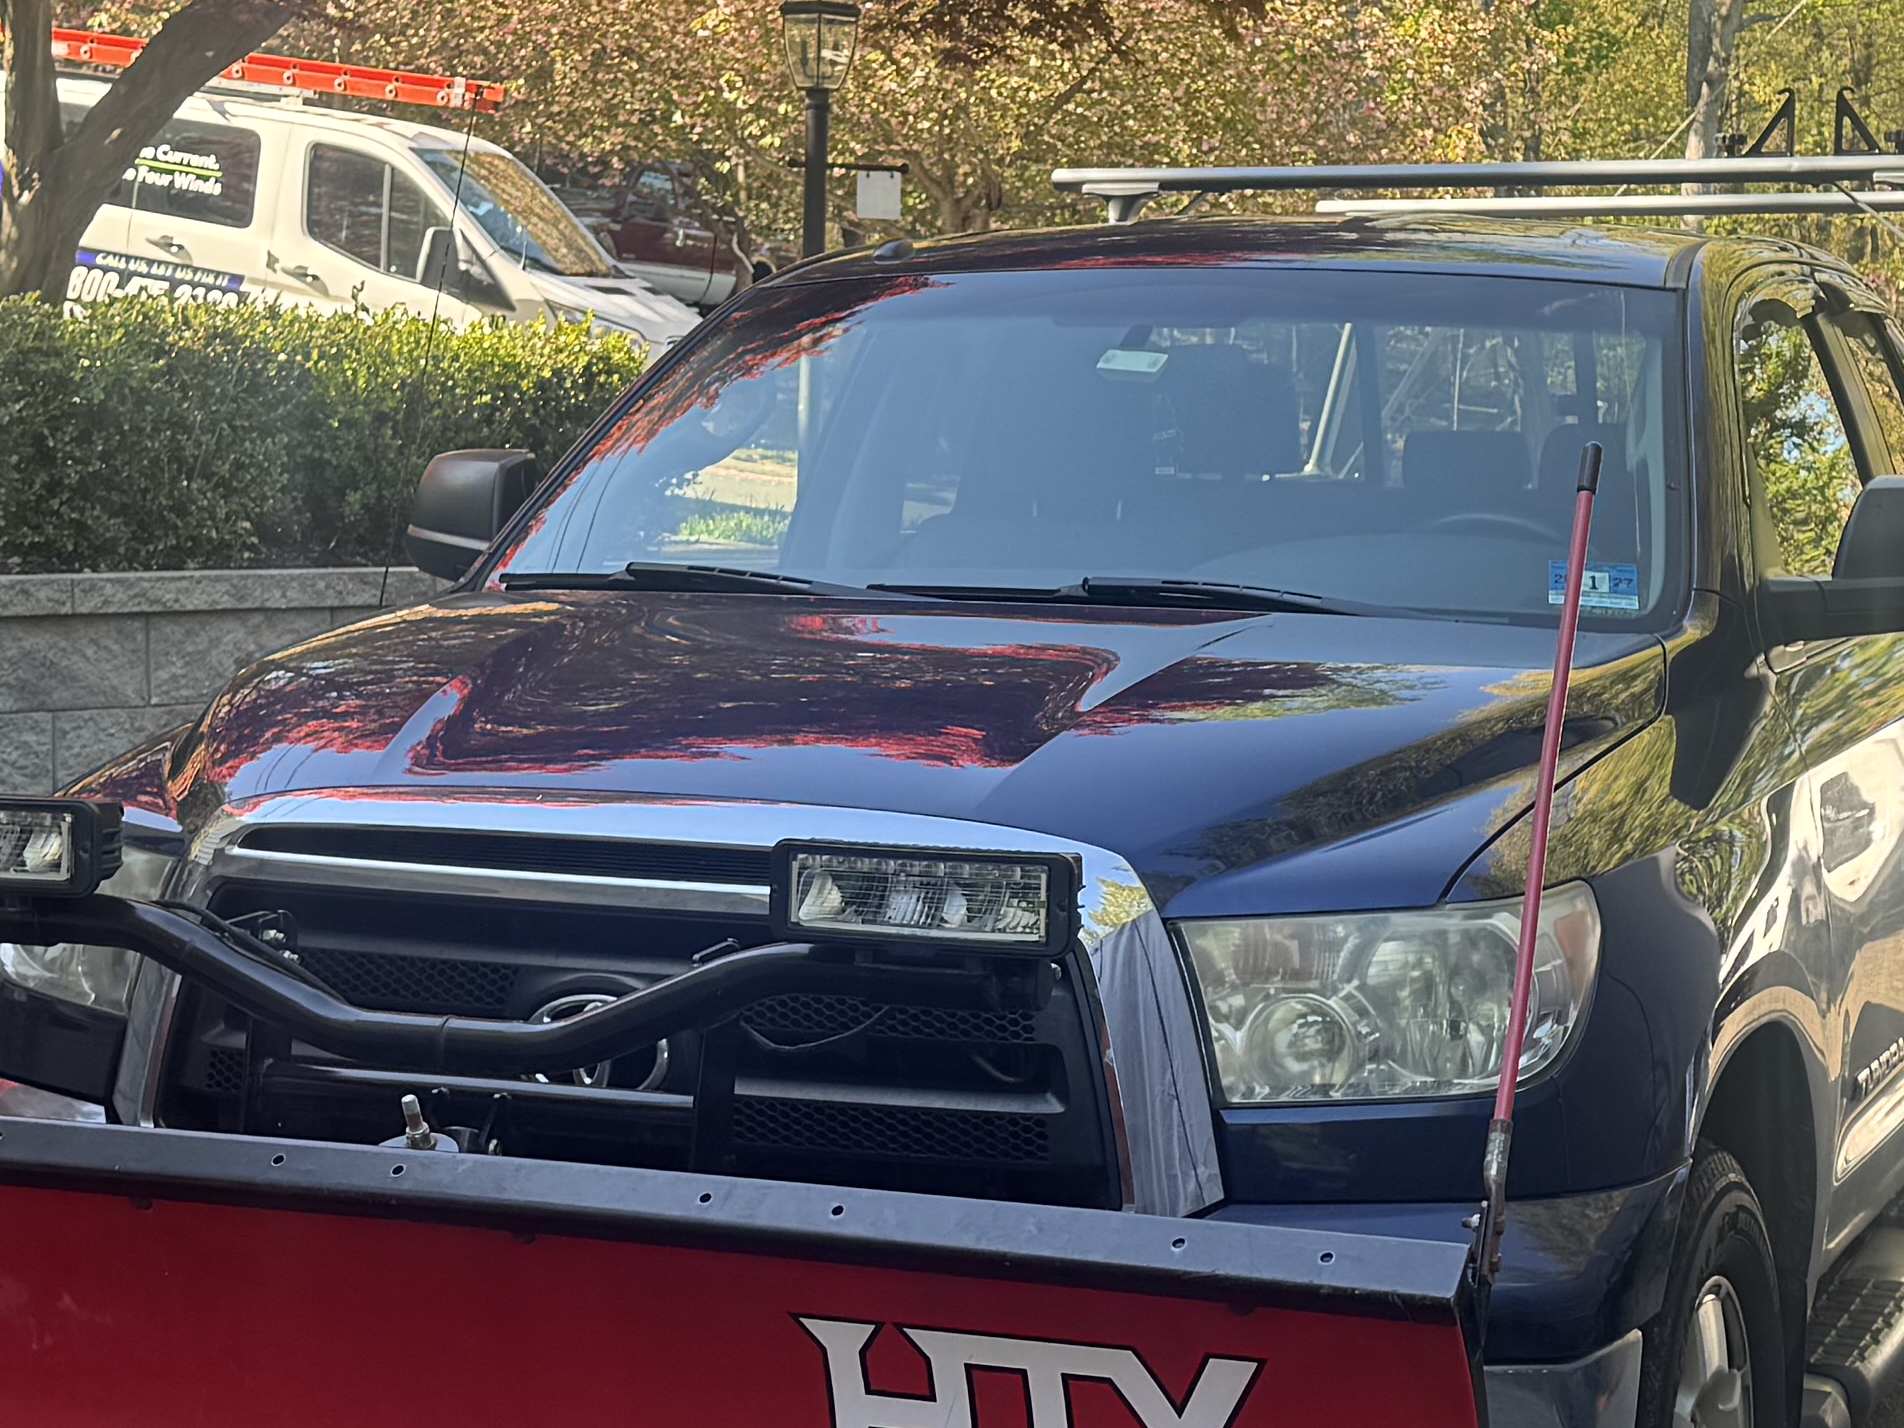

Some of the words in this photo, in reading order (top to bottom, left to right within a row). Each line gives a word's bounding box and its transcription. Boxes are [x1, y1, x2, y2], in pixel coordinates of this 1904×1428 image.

[138, 166, 173, 187] Four
[174, 171, 223, 196] Winds
[95, 252, 127, 269] CALL
[1589, 575, 1599, 590] 1
[1612, 577, 1633, 588] 27
